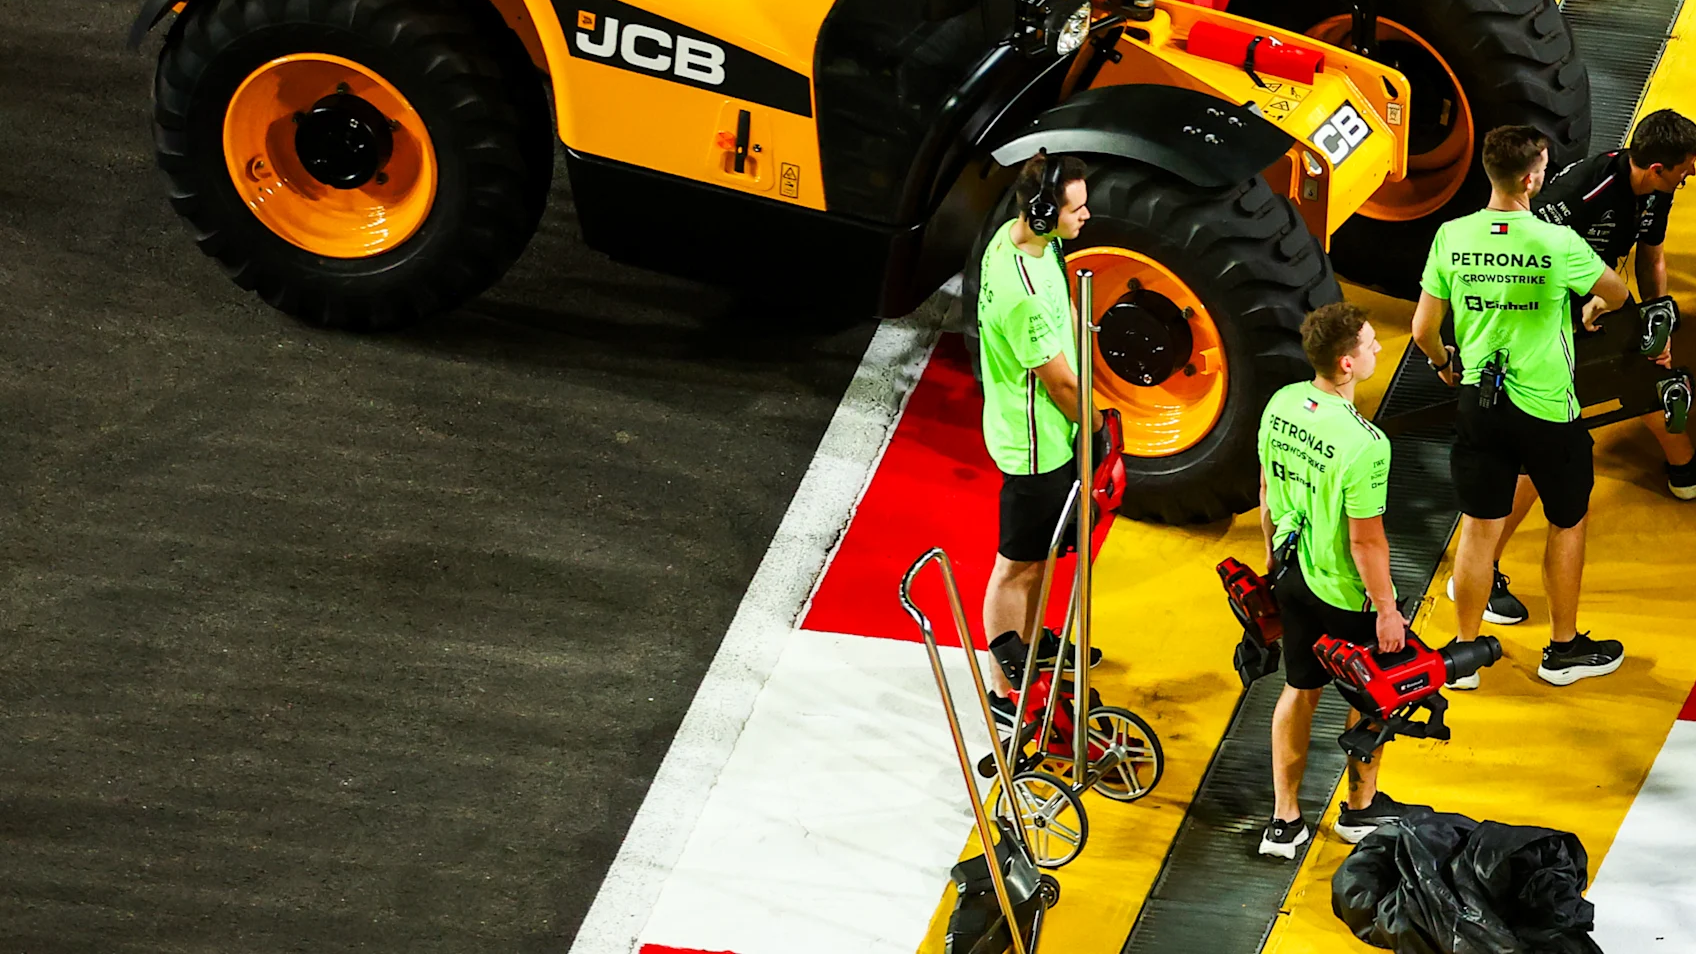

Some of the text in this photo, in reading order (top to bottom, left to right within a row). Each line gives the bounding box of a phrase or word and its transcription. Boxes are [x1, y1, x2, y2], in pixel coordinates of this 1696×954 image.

[576, 17, 725, 85] JCB
[1451, 252, 1552, 269] PETRONAS
[1462, 274, 1546, 285] CROWDSTRIKE
[1485, 301, 1539, 311] Einhell
